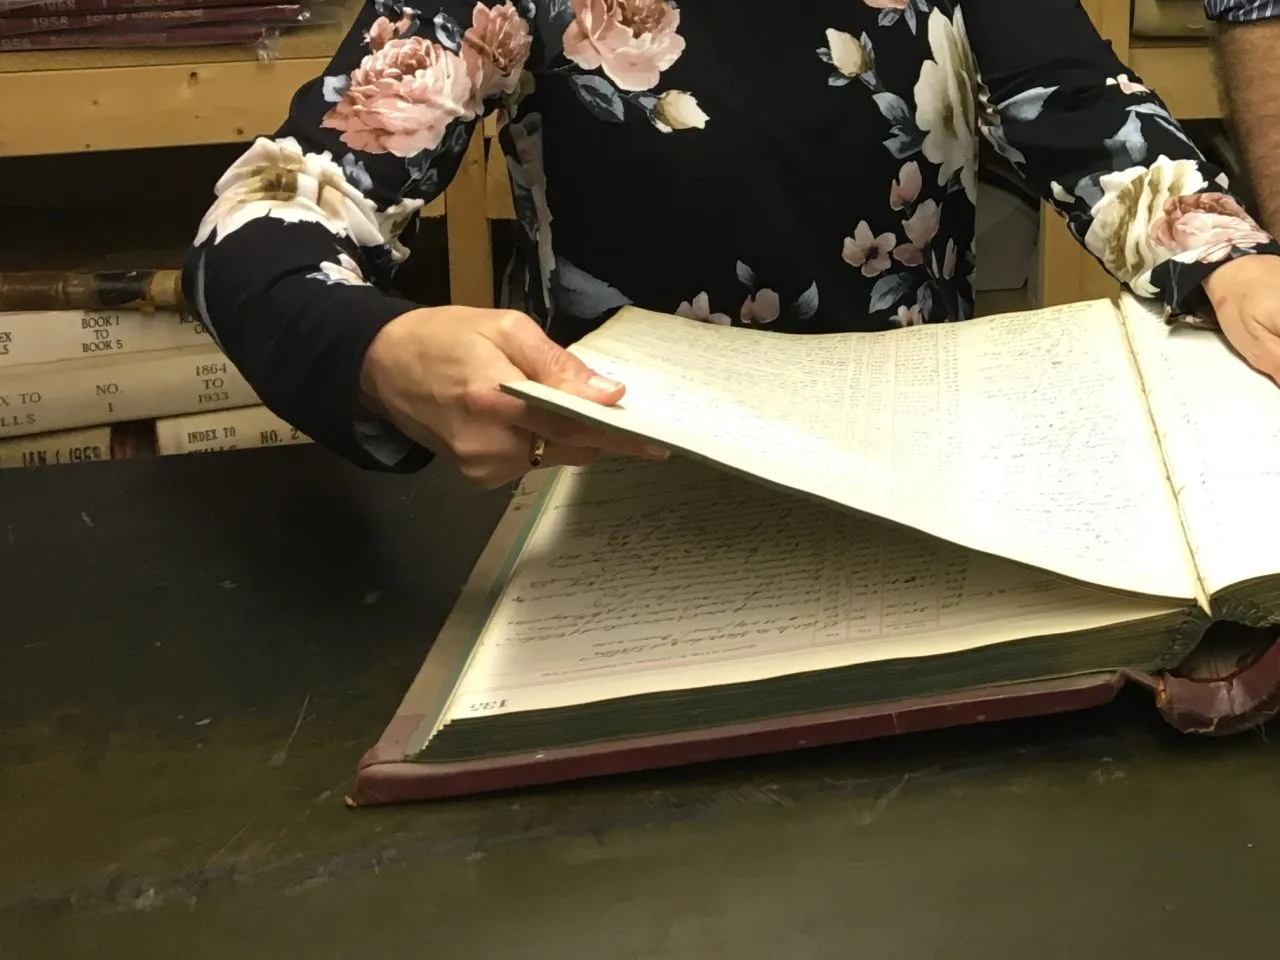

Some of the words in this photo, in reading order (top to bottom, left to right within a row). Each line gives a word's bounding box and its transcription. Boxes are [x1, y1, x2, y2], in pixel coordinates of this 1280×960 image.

[81, 316, 113, 329] BOOK
[93, 329, 110, 340] TO
[82, 341, 113, 353] BOOK
[116, 339, 124, 349] 5
[195, 363, 227, 377] 1864
[202, 378, 224, 390] TO
[19, 392, 42, 405] TO
[197, 392, 230, 404] 1933
[0, 414, 36, 427] LLS
[187, 429, 217, 443] INDEX
[222, 426, 236, 438] TO
[260, 429, 283, 445] NO.
[290, 428, 300, 440] 2
